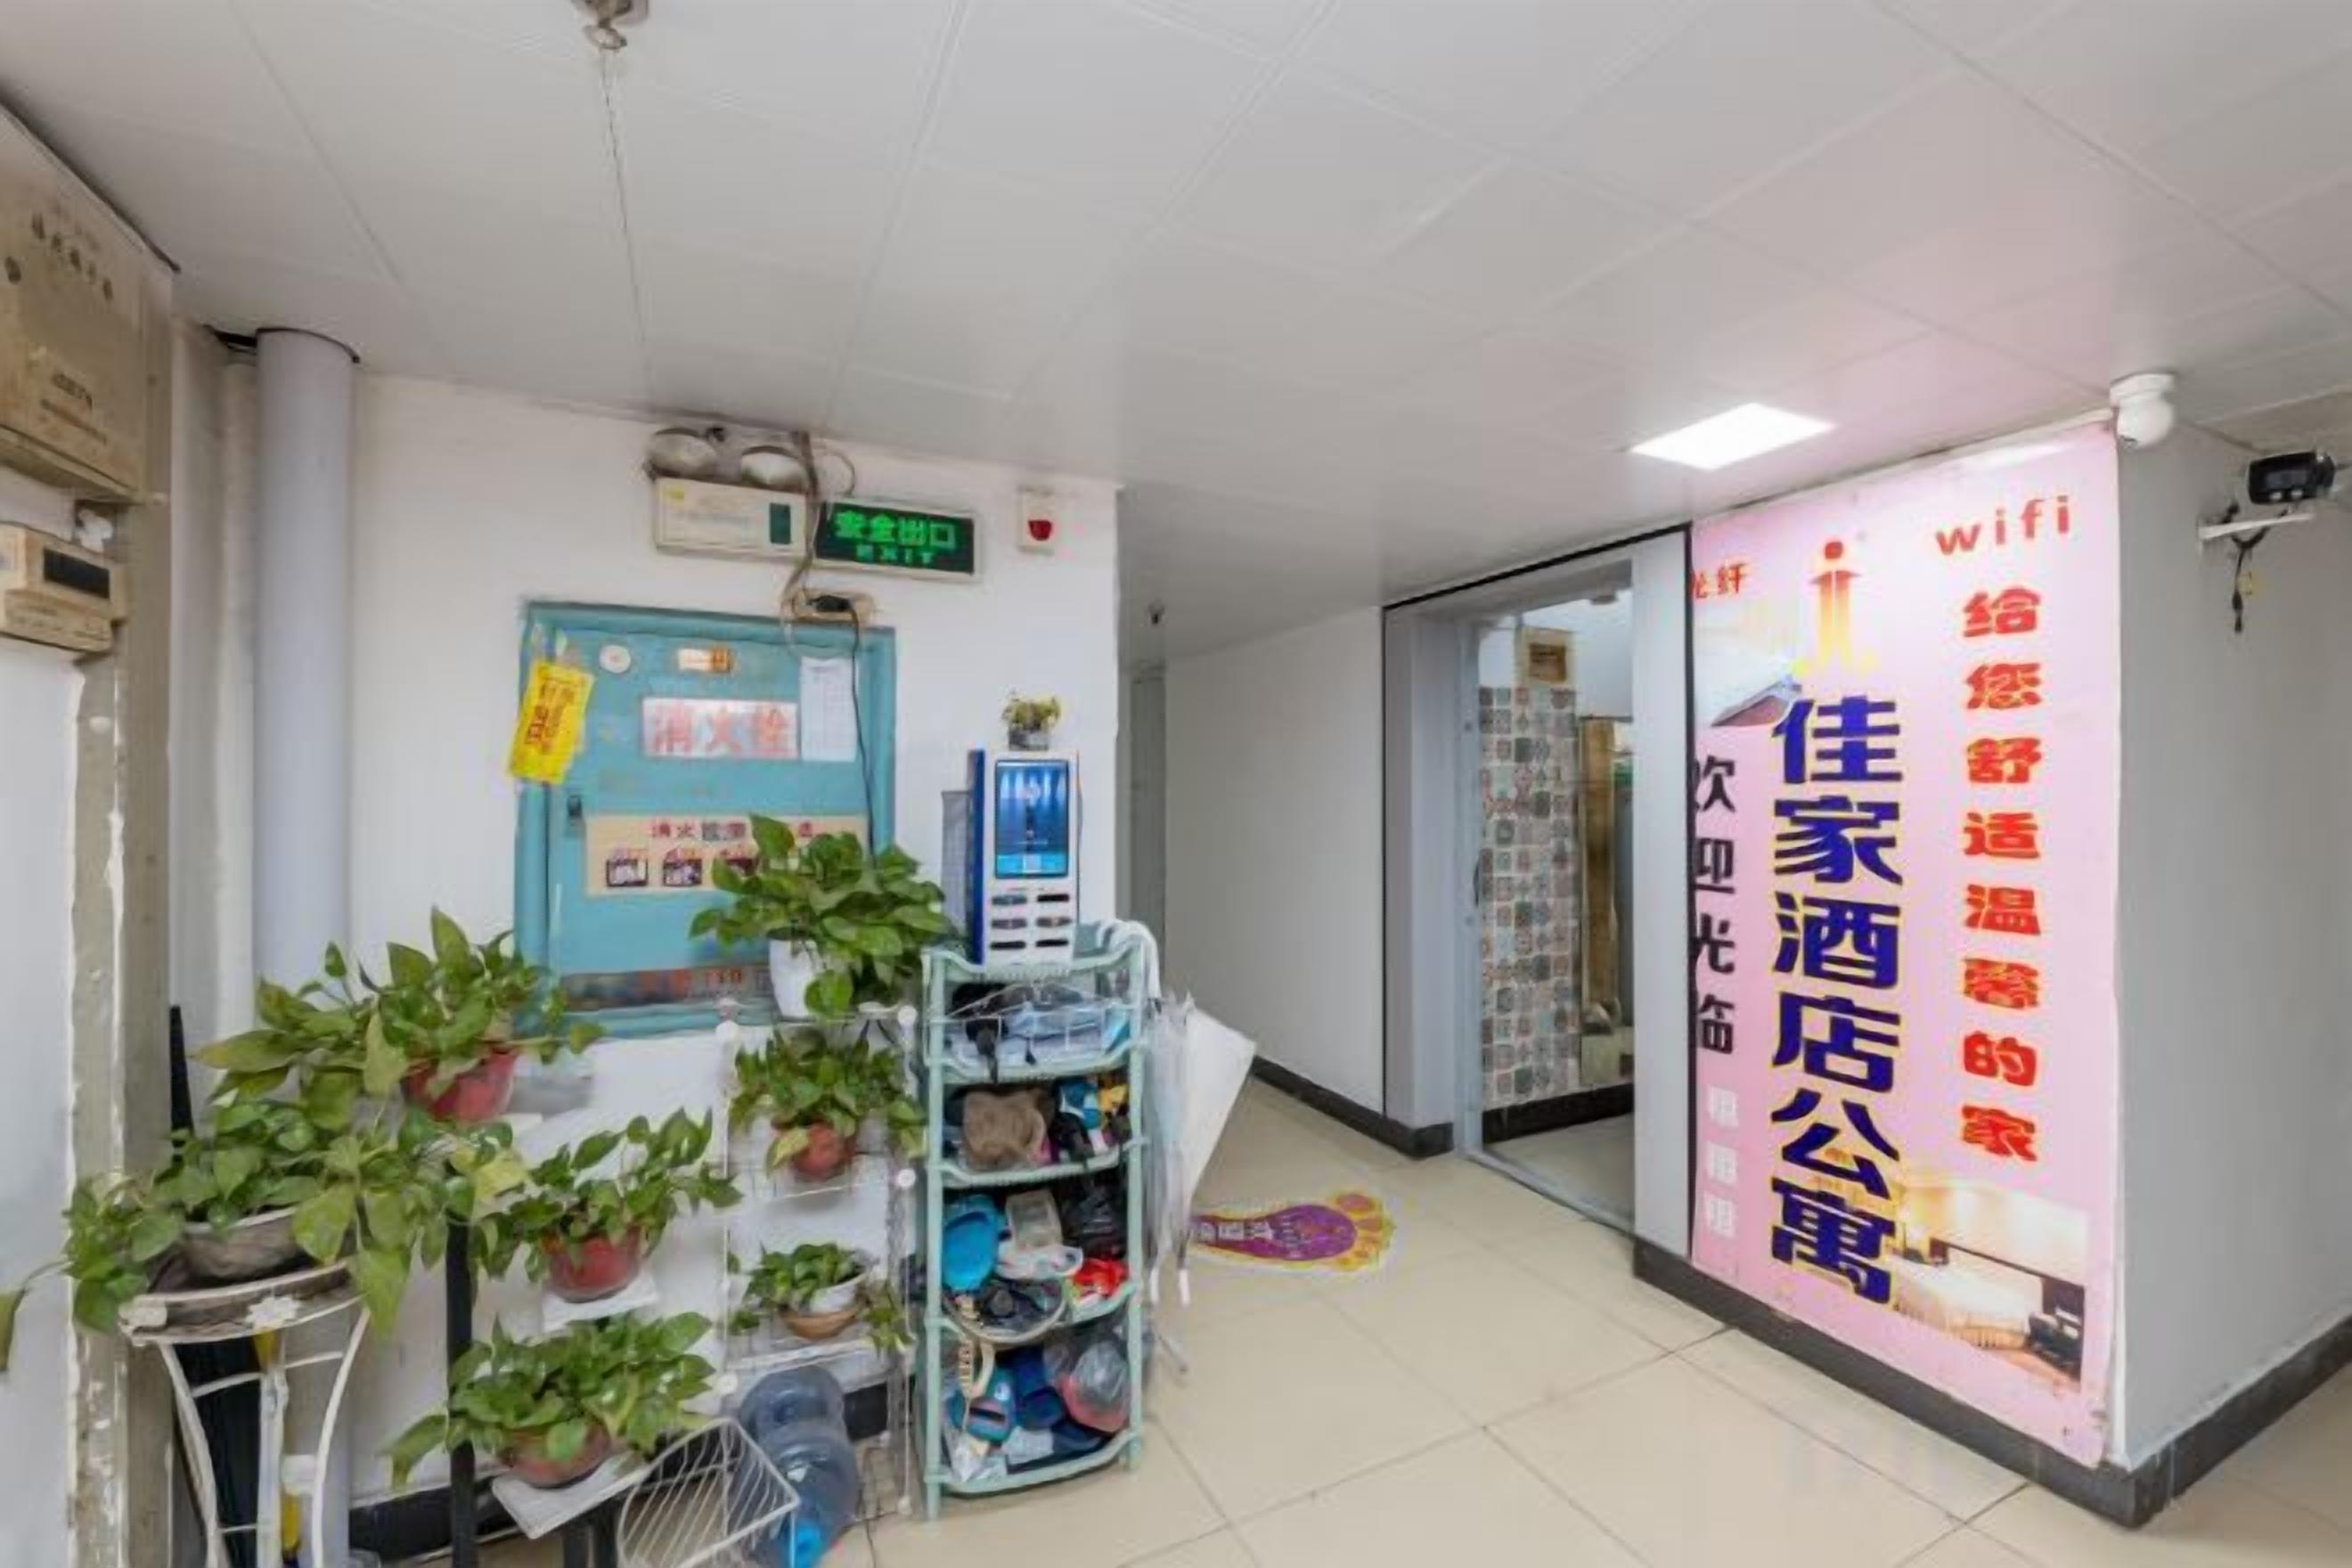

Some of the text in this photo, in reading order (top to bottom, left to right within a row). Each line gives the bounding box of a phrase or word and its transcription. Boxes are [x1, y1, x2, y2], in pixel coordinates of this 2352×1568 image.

[836, 511, 956, 550] 安全出口
[1936, 495, 2071, 555] wifi
[651, 702, 790, 753] 消火栓
[1963, 587, 2043, 1161] 给您舒适温馨的家
[1771, 696, 1902, 1305] 佳家酒店公寓
